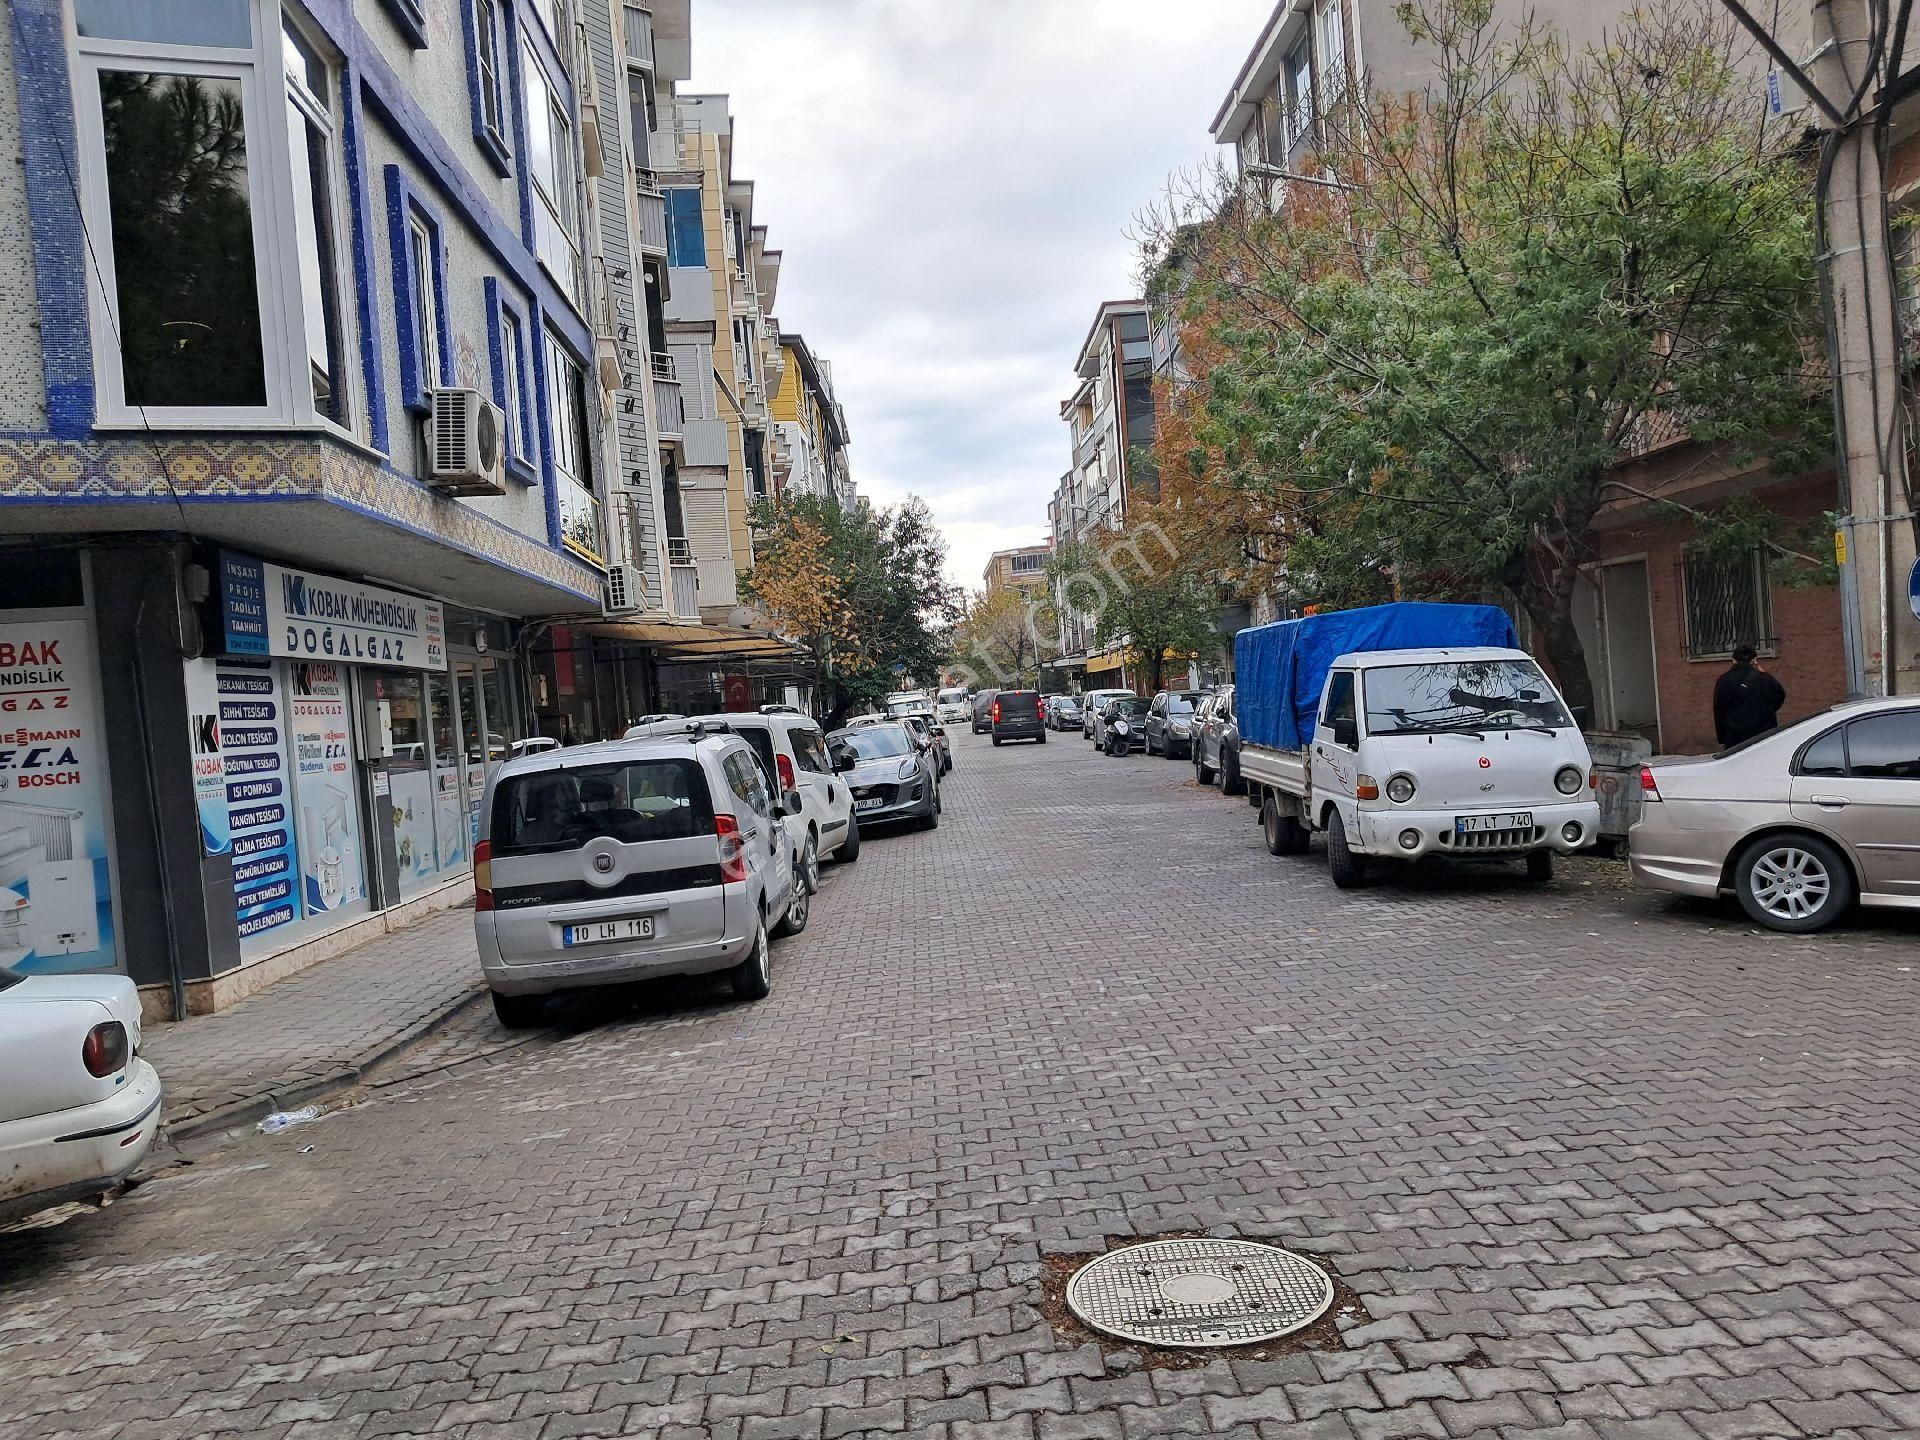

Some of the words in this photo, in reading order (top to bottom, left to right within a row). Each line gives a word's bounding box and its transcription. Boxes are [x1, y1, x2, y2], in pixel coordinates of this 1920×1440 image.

[229, 583, 260, 599] PROJE
[308, 587, 350, 621] KOBAK
[351, 592, 417, 632] MÜHENDİSLİK
[287, 626, 404, 661] DOĞALGAZ
[310, 662, 338, 683] KOBAK
[242, 706, 269, 718] TESİSAT
[222, 733, 247, 746] KOLON
[195, 758, 223, 777] KOBAK
[300, 761, 325, 772] Buderus
[18, 771, 81, 788] BOSCH
[243, 783, 273, 797] POMPASI
[231, 812, 255, 827] YANGIN
[1465, 818, 1477, 830] 17
[1484, 816, 1497, 829] LT
[1510, 814, 1530, 828] 740
[235, 839, 254, 855] KLİMA
[264, 861, 285, 875] KAZAN
[238, 894, 257, 908] PETEK
[238, 907, 291, 938] PROJELENDİRME
[575, 926, 589, 941] 10
[600, 922, 616, 938] LH
[628, 919, 651, 935] 116
